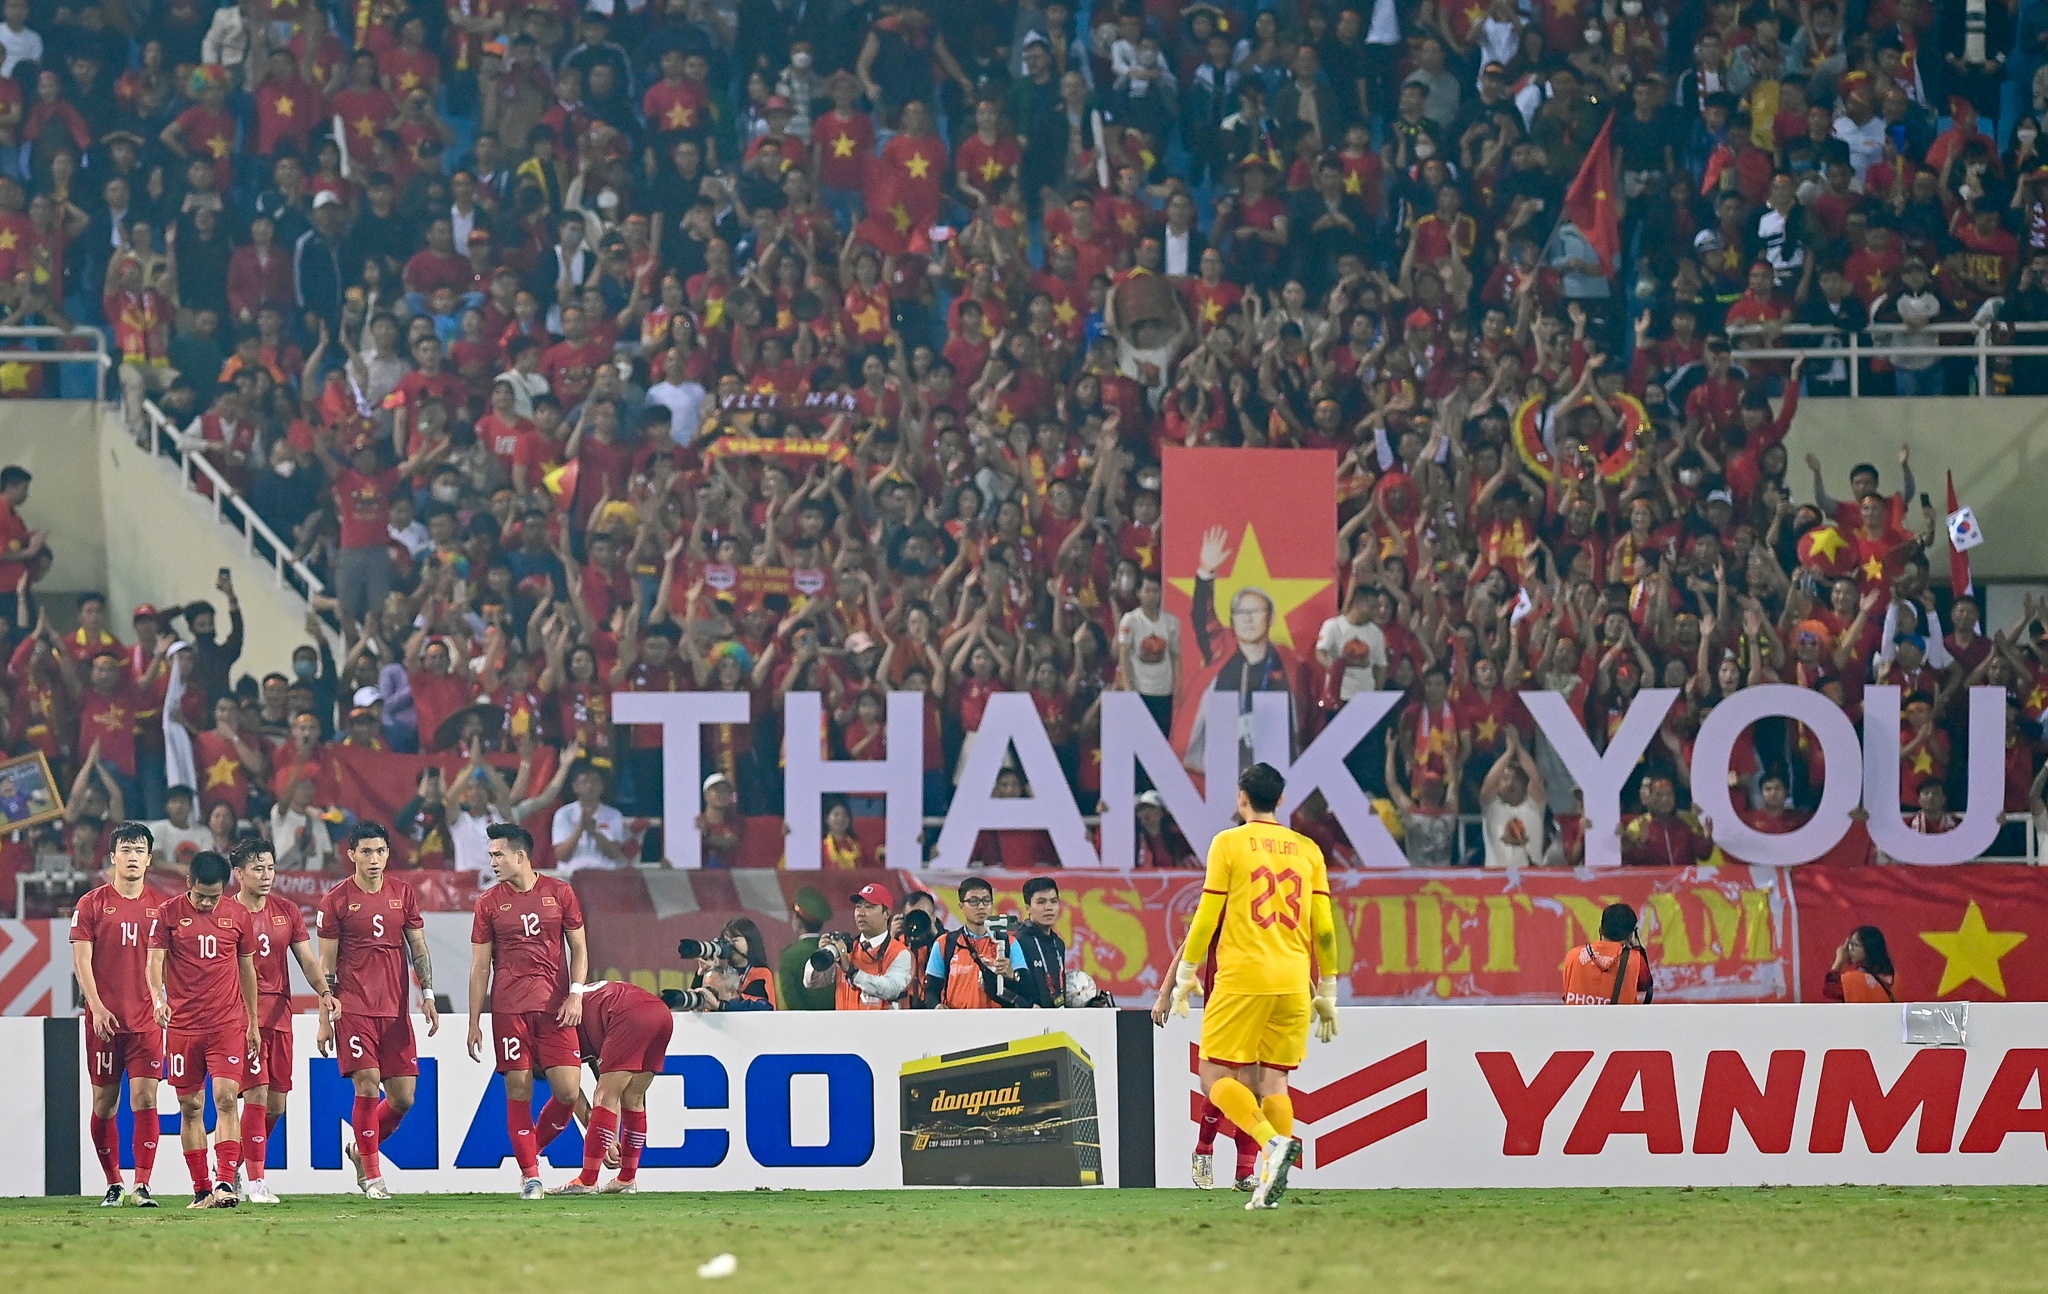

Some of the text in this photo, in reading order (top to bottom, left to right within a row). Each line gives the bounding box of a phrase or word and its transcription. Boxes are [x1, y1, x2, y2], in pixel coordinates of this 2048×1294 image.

[612, 684, 2007, 870] THANK YOU
[1250, 865, 1302, 931] 23
[120, 921, 138, 947] 14
[520, 911, 541, 937] 12
[1554, 887, 1776, 972] NAM
[198, 934, 217, 959] 10
[257, 933, 271, 957] 3
[502, 1036, 521, 1061] 12
[95, 1051, 113, 1076] 14
[169, 1052, 185, 1078] 10
[117, 1053, 875, 1170] NACO
